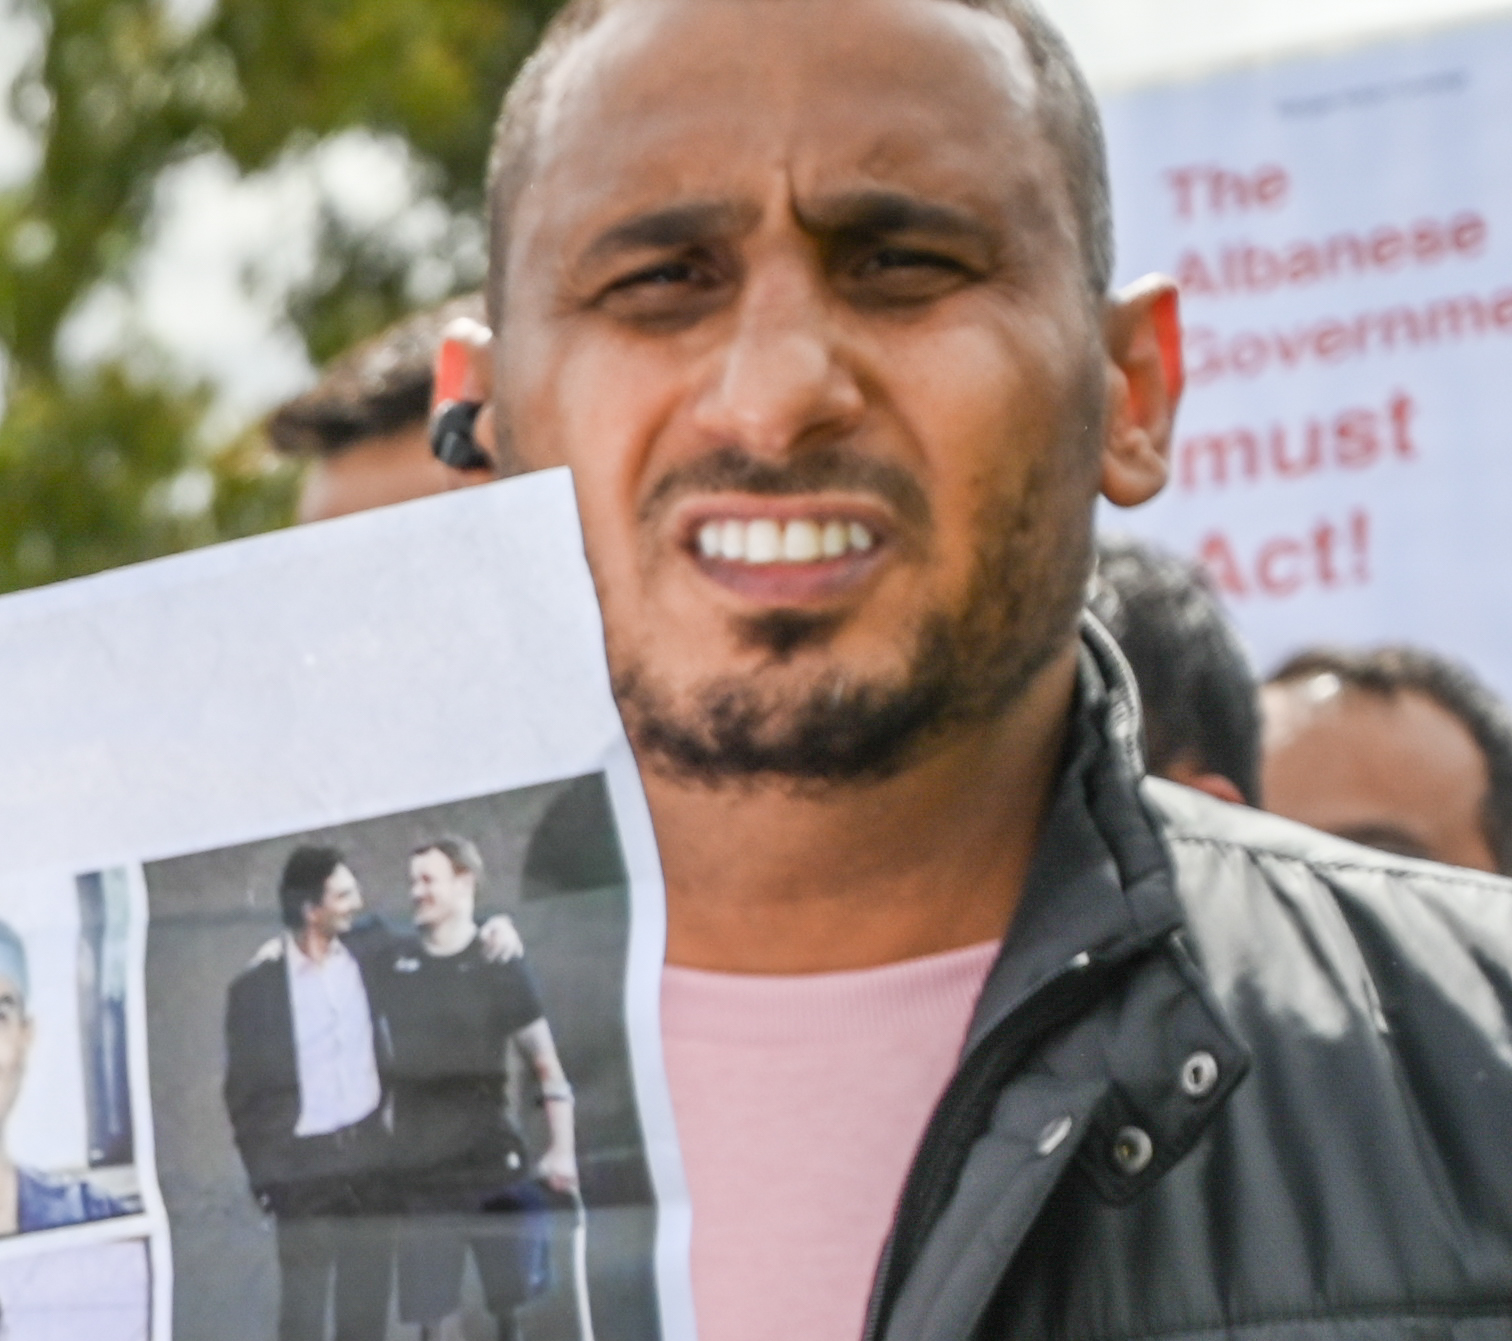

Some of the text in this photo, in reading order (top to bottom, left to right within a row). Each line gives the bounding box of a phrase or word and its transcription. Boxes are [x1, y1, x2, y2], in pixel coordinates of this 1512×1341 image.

[1165, 162, 1290, 219] The
[1176, 209, 1488, 295] Albanese
[1179, 387, 1420, 491] must
[1197, 505, 1372, 599] Act!
